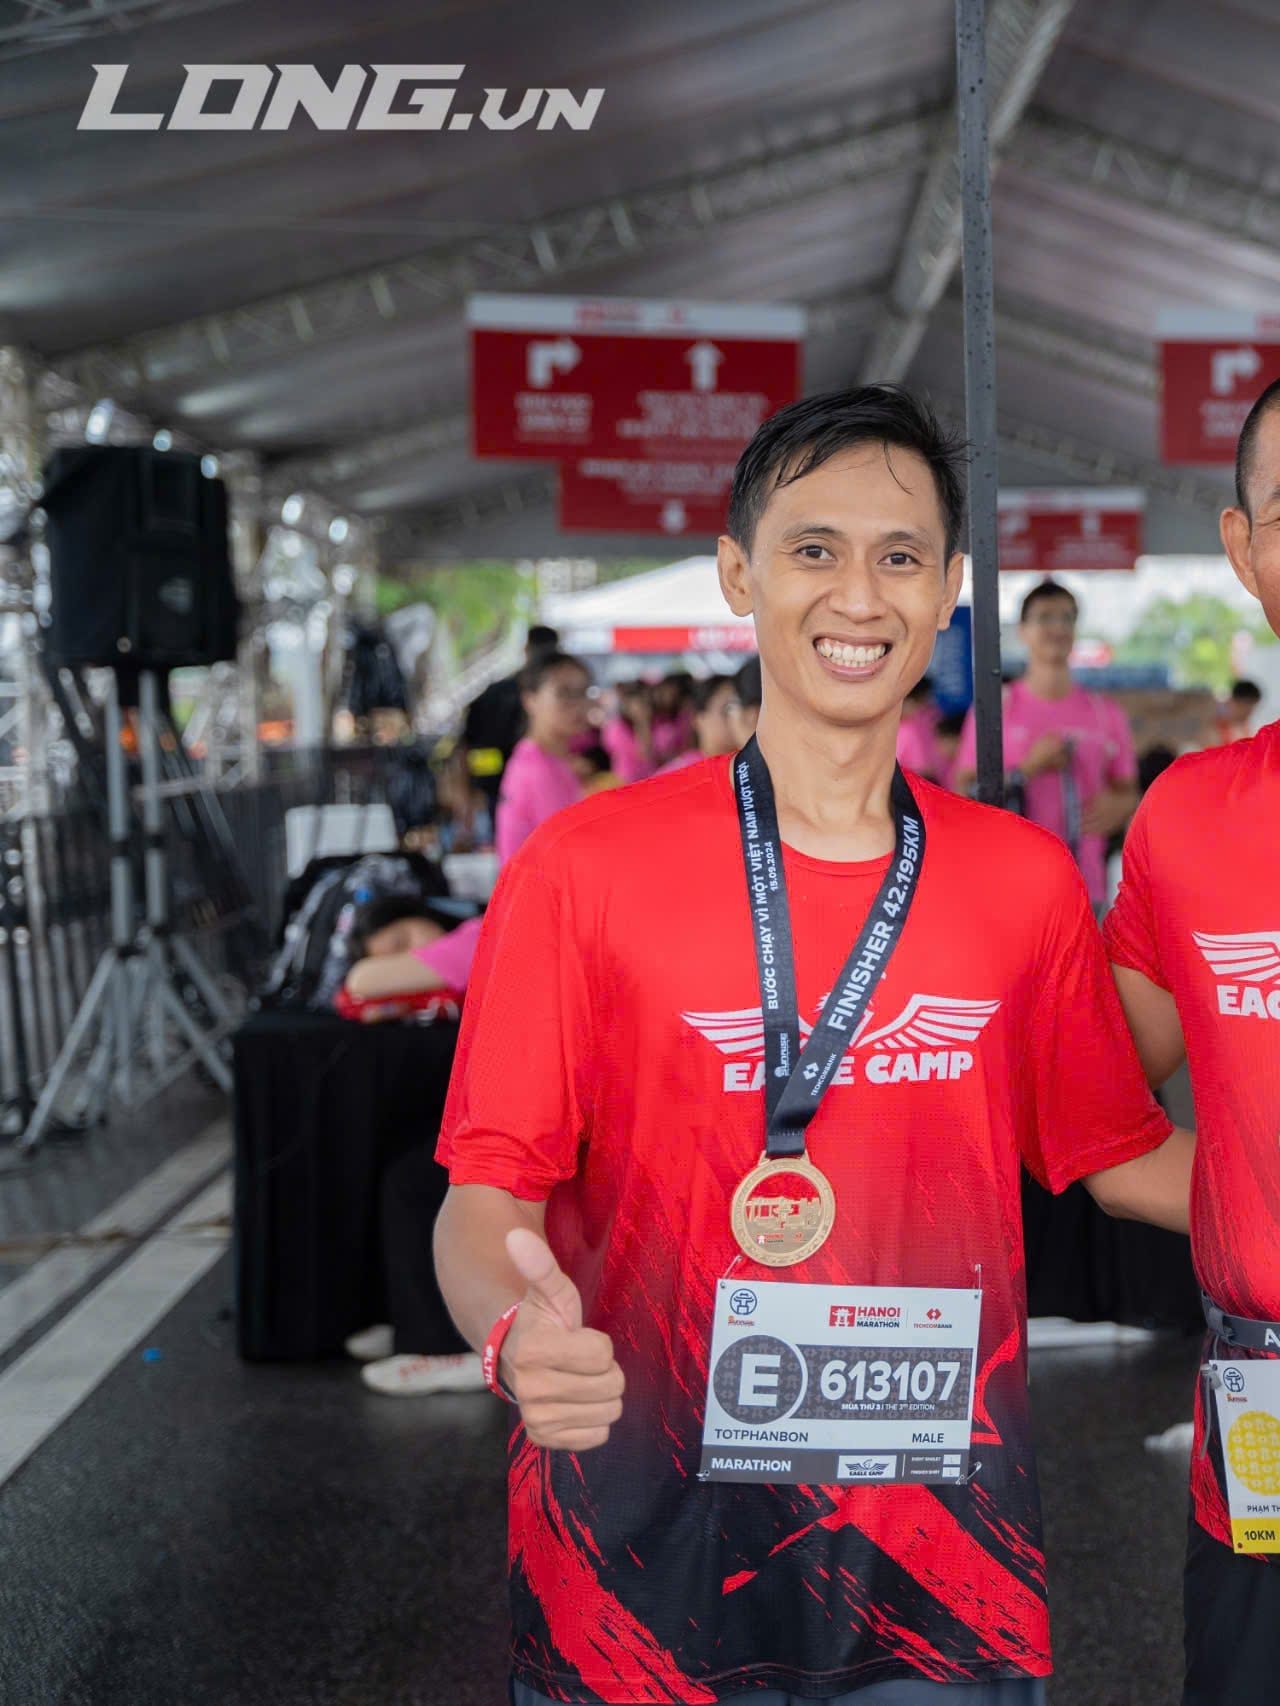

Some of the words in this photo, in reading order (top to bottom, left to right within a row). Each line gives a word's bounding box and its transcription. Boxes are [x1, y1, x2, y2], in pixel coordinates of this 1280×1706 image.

[745, 811, 759, 840] NAM
[748, 843, 764, 872] VIỆT
[764, 841, 779, 892] 15.09.2024
[752, 875, 769, 905] MỘT
[755, 907, 769, 925] VÌ
[828, 921, 894, 1032] FINISHER
[883, 815, 922, 918] 42.195KM
[760, 926, 775, 965] CHẠY
[763, 968, 779, 1010] BƯỚC
[723, 1055, 855, 1093] EAE
[864, 1051, 974, 1084] CAMP
[856, 1320, 900, 1328] MARATHON
[857, 1306, 901, 1318] HANOI
[738, 1353, 781, 1407] E
[819, 1360, 961, 1402] 613107
[714, 1428, 809, 1443] TOTPHANBON
[911, 1432, 945, 1444] MALE
[711, 1457, 792, 1473] MARATHON
[1244, 1530, 1276, 1541] 10KM
